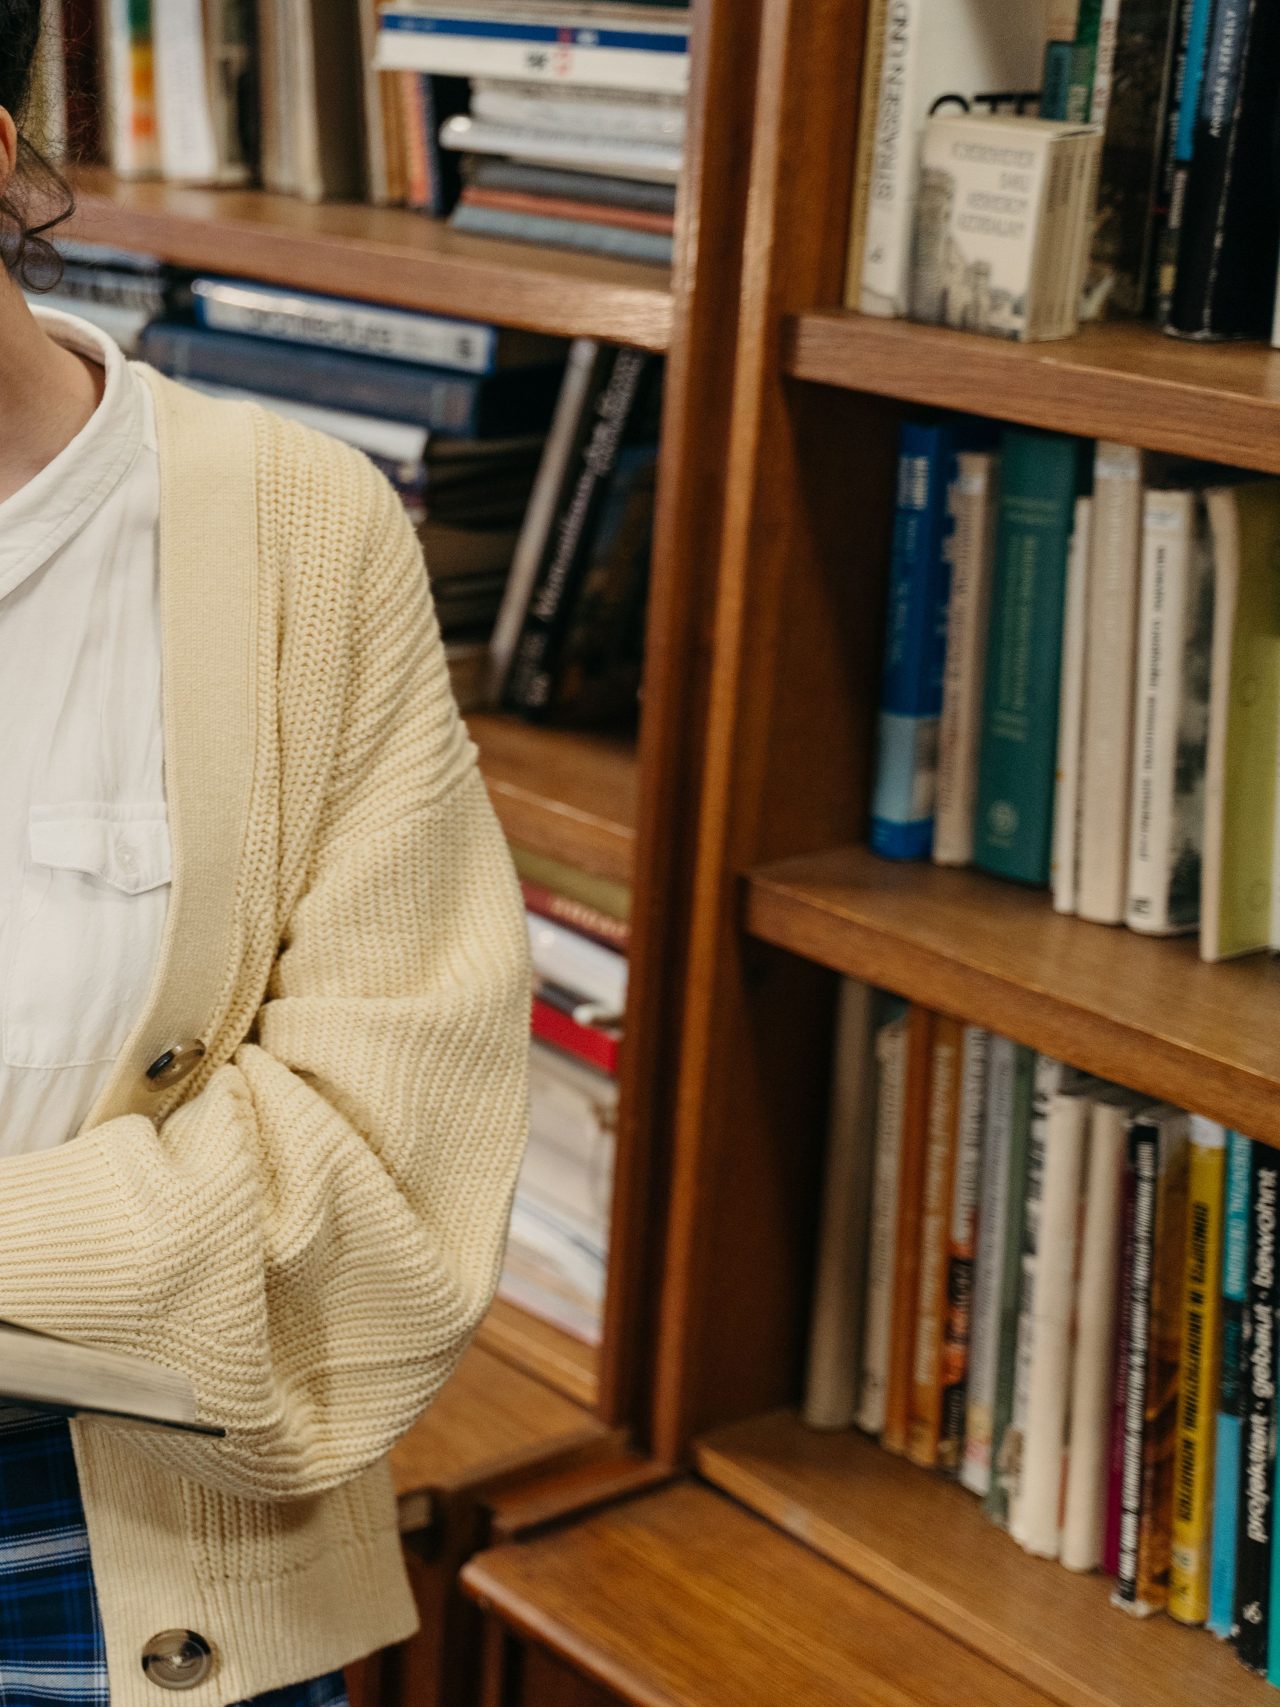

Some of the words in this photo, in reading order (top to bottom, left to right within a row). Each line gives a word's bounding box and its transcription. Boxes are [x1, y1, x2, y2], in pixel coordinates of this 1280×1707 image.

[1251, 1166, 1278, 1288] bewohnt
[1249, 1303, 1276, 1399] gebaut
[1245, 1413, 1270, 1544] projektiert
